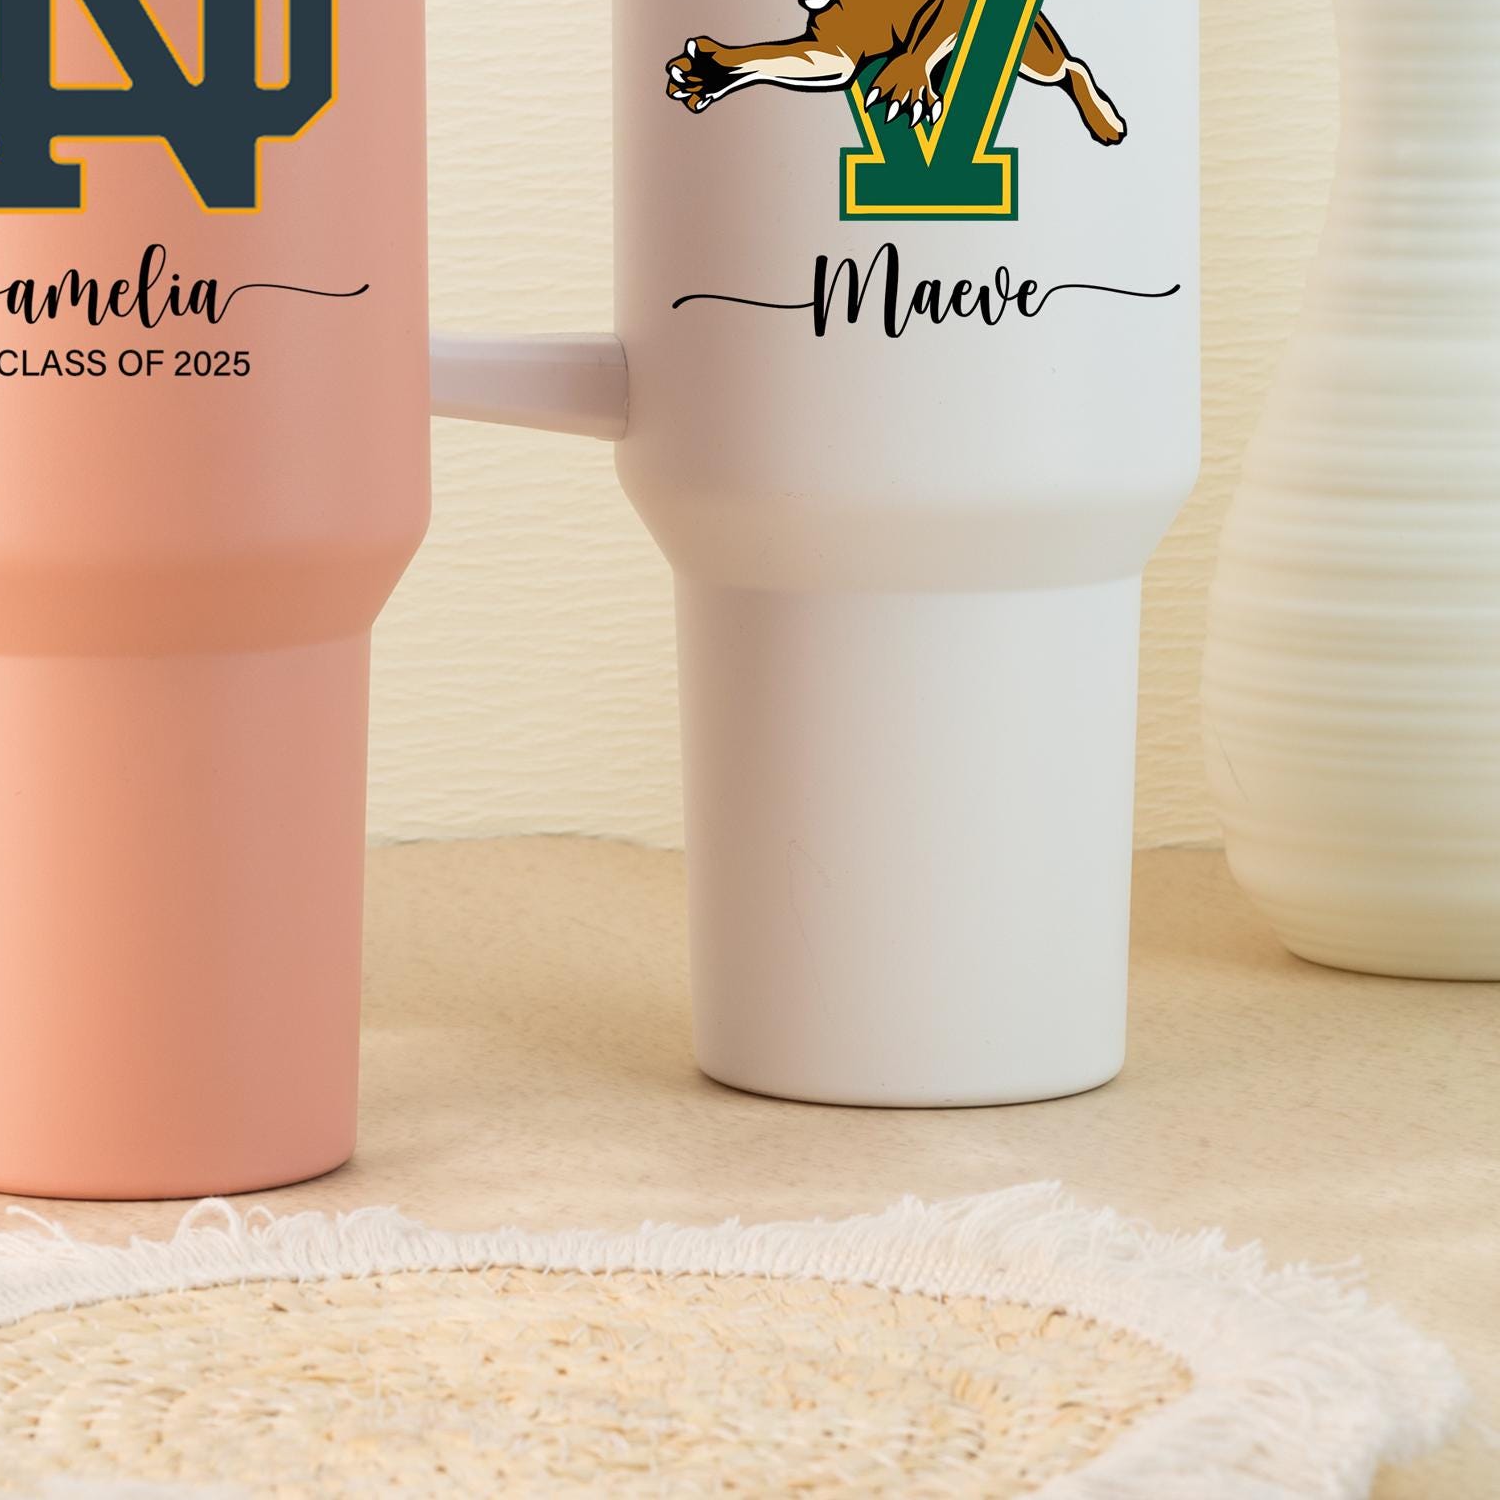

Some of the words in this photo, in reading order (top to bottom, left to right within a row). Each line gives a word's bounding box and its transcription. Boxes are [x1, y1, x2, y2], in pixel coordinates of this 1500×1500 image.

[6, 243, 224, 329] amelia
[813, 242, 1048, 339] Maeve
[118, 349, 164, 377] OF
[174, 350, 251, 377] 2025
